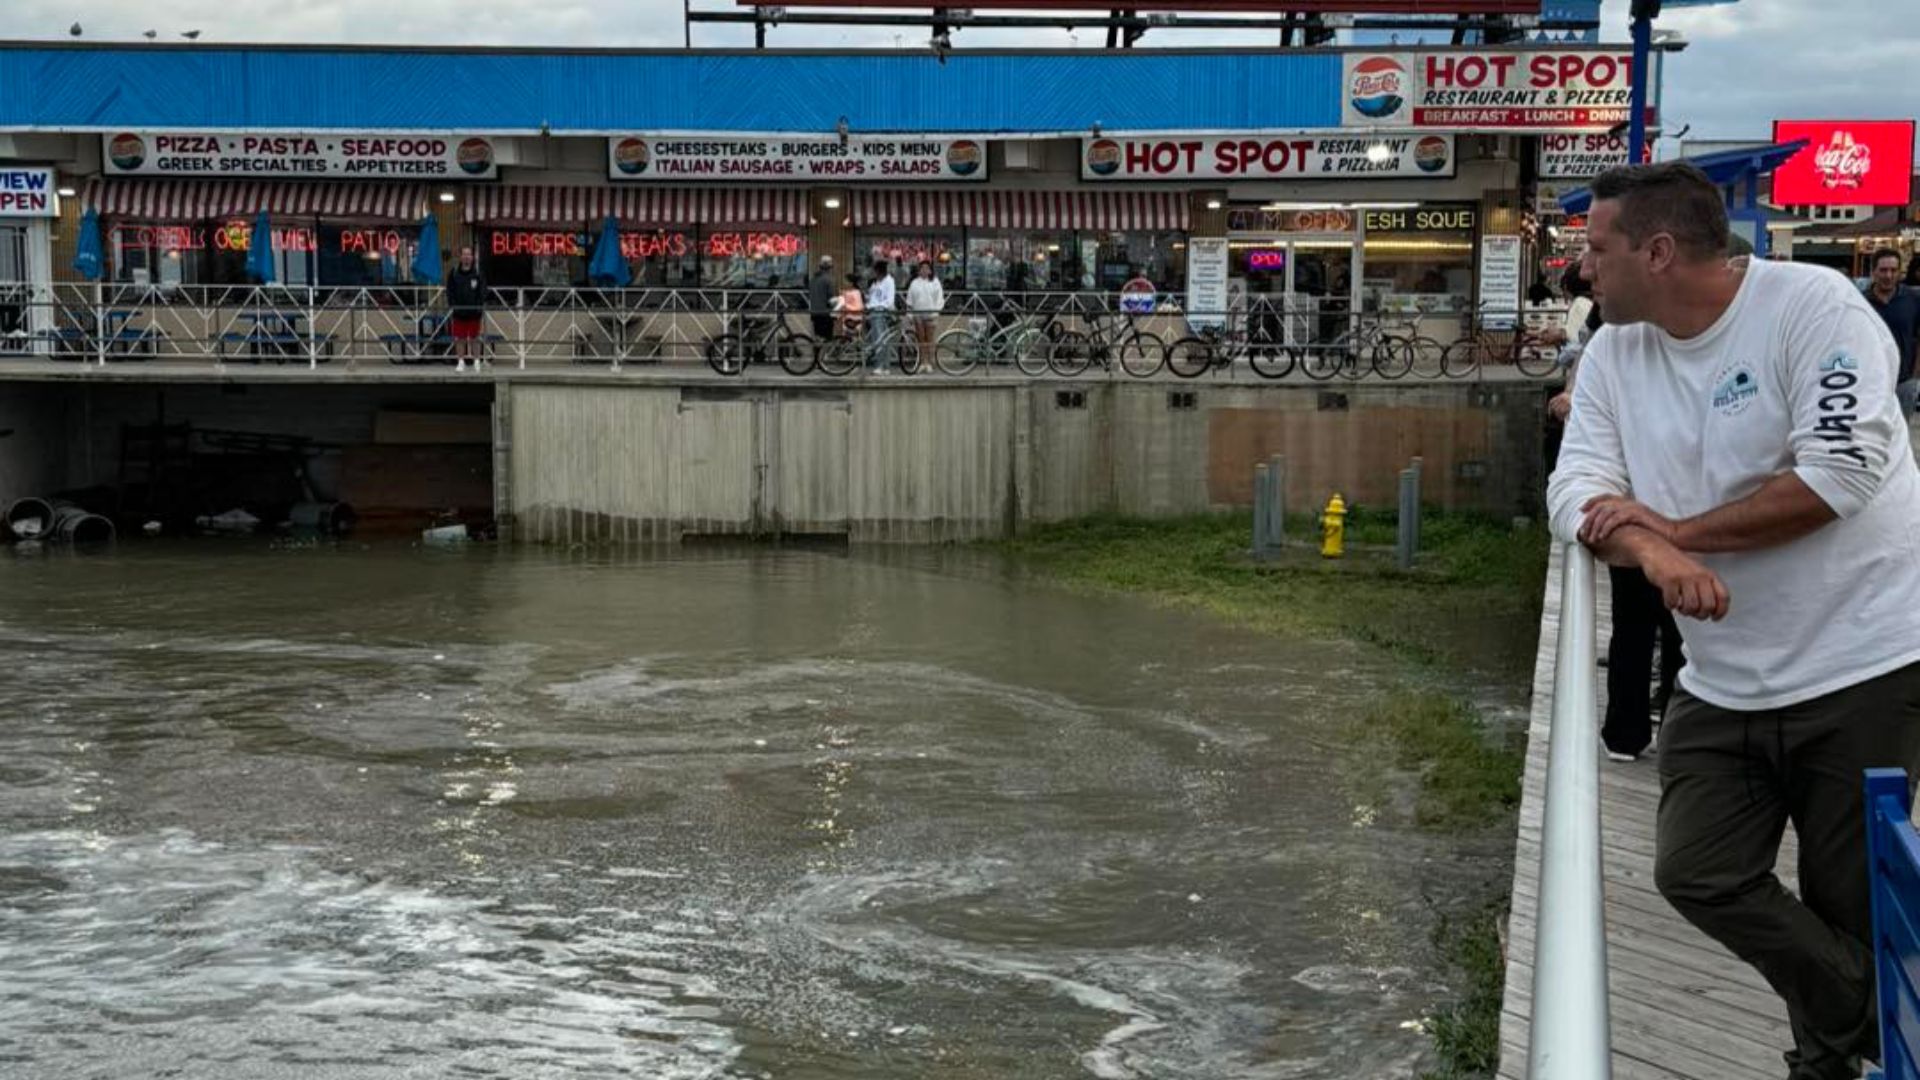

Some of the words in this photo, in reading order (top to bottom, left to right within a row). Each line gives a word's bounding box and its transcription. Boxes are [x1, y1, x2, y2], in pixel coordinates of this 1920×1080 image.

[1426, 55, 1517, 88] HOT
[1424, 89, 1540, 105] RESTAURANT
[1545, 90, 1557, 104] &
[1564, 89, 1633, 105] PIZZERI
[1423, 110, 1510, 123] BREAKFAST
[1525, 109, 1576, 122] LUNCH
[1589, 109, 1632, 121] DINNE
[156, 137, 221, 153] PIZZA
[243, 138, 319, 155] PASTA
[341, 139, 446, 156] SEAFOOD
[655, 142, 767, 156] CHEESESTEAKS
[782, 143, 848, 157] BURGERS
[863, 144, 896, 156] KIDS
[901, 144, 941, 156] MENU
[1543, 134, 1579, 151] HOT
[1585, 135, 1624, 151] SPO
[157, 157, 213, 171] GREEK
[220, 158, 327, 172] SPECIALTIES
[344, 160, 447, 173] APPETIZERS
[1125, 142, 1203, 174] HOT
[1214, 140, 1314, 173] SPOT
[1322, 157, 1333, 172] &
[1546, 154, 1628, 163] RESTAURANT
[655, 159, 715, 174] ITALIAN
[720, 158, 793, 174] SAUSAGE
[810, 160, 865, 175] WRAPS
[881, 160, 941, 175] SALADS
[0, 192, 46, 210] PEN
[1366, 211, 1405, 230] ESH
[492, 232, 577, 256] BURGERS
[1251, 252, 1283, 267] OPEN
